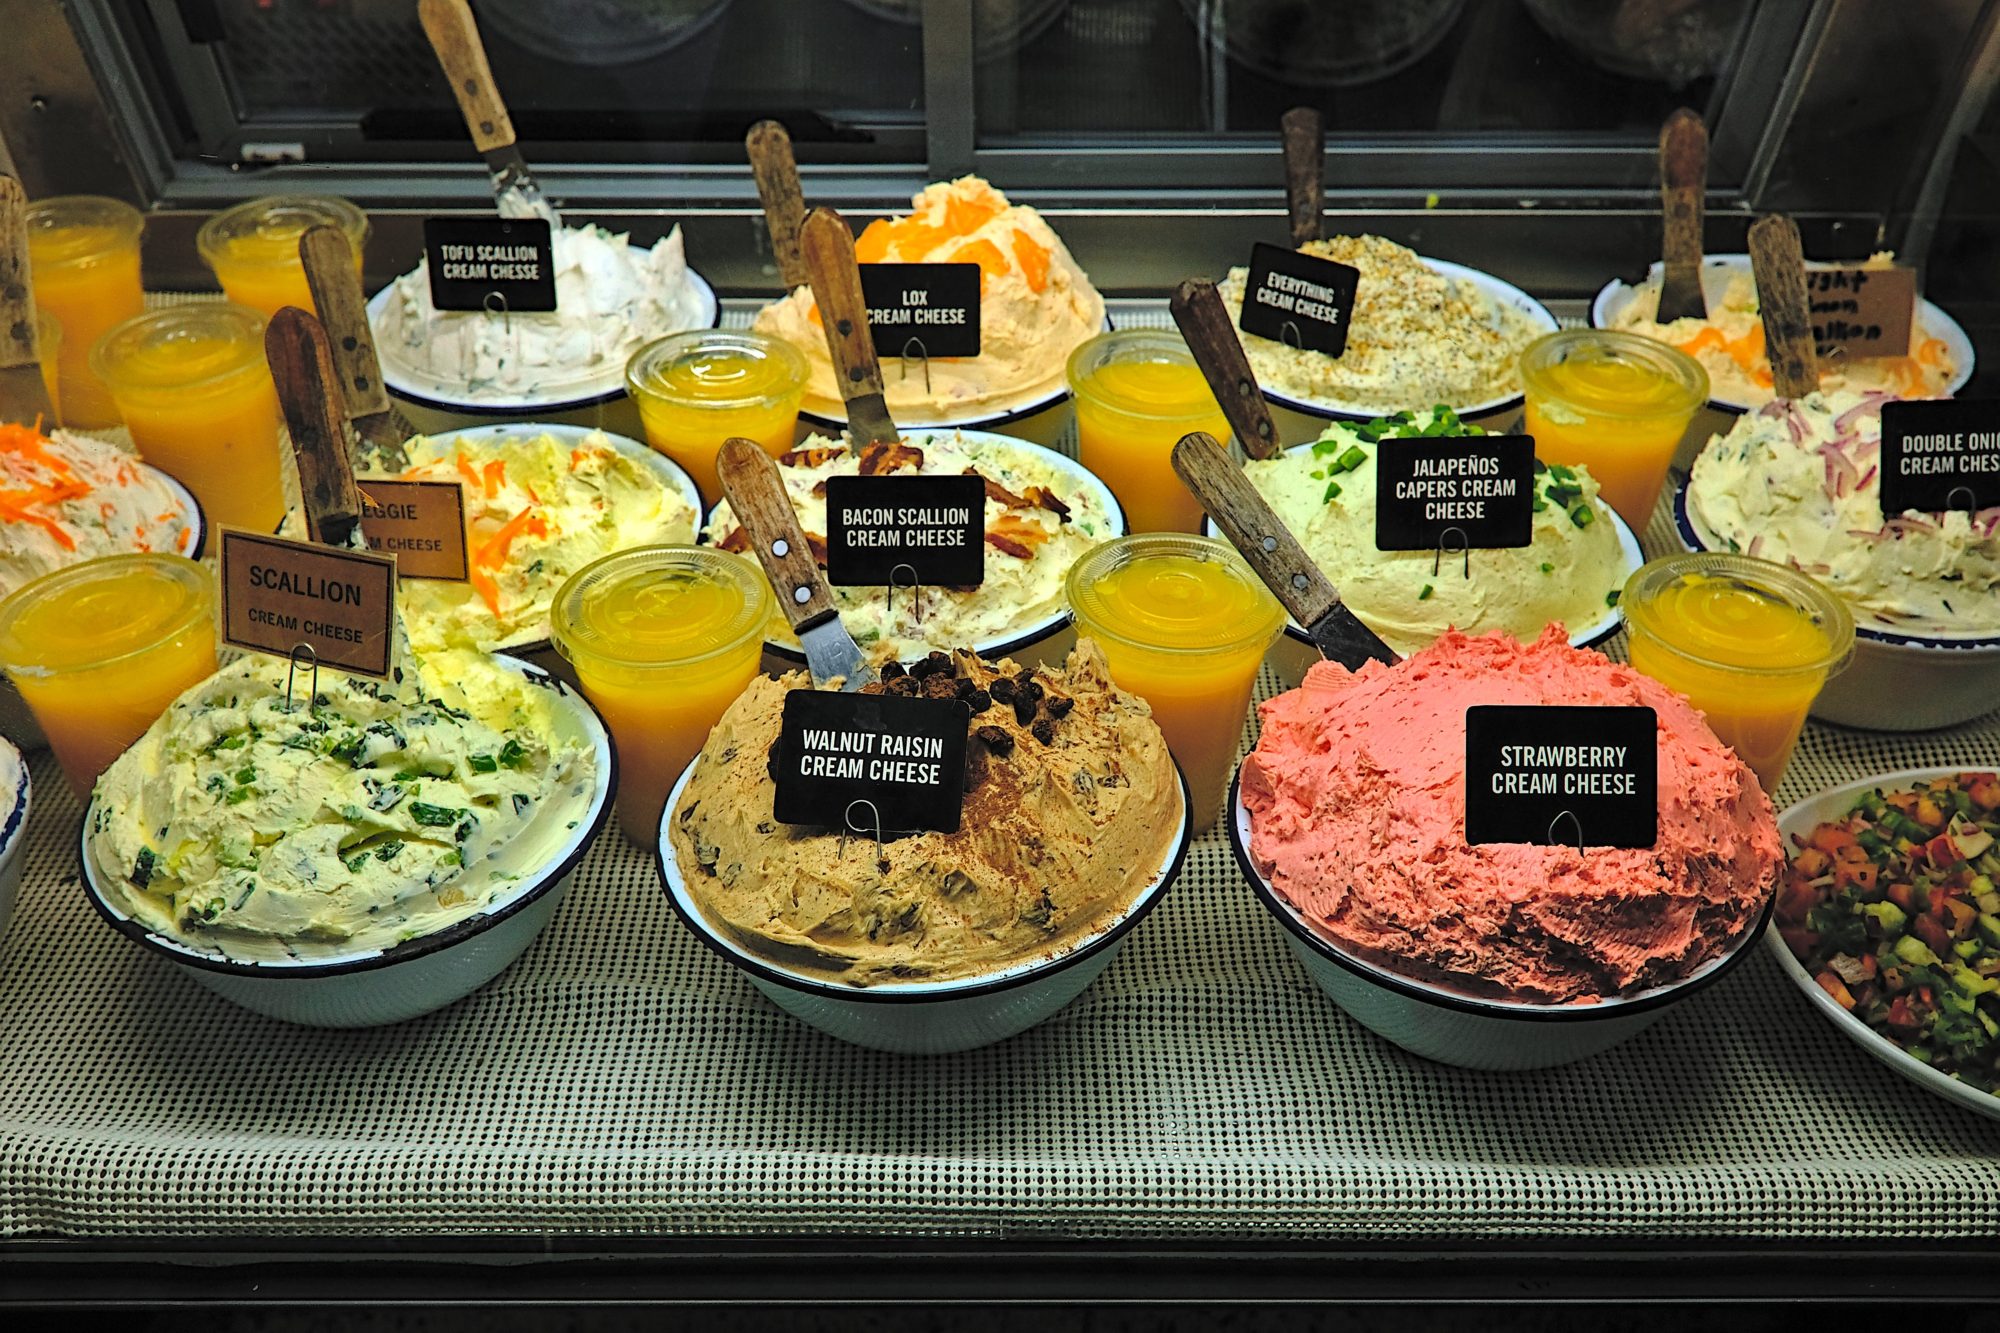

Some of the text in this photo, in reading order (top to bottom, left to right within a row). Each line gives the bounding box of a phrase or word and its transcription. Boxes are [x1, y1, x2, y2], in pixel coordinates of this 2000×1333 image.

[441, 245, 538, 261] TOFU SCALLION
[443, 263, 540, 280] CREAM CHESSE
[1267, 271, 1335, 304] EVERYTHING
[902, 290, 928, 306] LOX
[1256, 287, 1340, 324] CREAM CHEESE
[914, 308, 966, 324] CHEESE
[1902, 433, 1964, 453] DOUBLE
[1412, 454, 1499, 477] JALAPEÑOS
[1900, 455, 1955, 475] CREAM
[1396, 478, 1516, 499] CAPERS CREAM
[361, 502, 418, 520] EGGIE
[842, 507, 969, 526] BACON SCALLION
[1425, 501, 1485, 520] CHEESE
[387, 536, 442, 551] CHEESE
[846, 529, 965, 547] CREAM CHEESE
[249, 565, 361, 607] SCALLION
[248, 607, 364, 644] CREAM CHEESE
[803, 729, 943, 759] WALNUT RAISIN
[1500, 745, 1627, 768] STRAWBERRY
[800, 755, 941, 785] CREAM CHEESE
[1492, 772, 1636, 795] CREAM CHEESE
